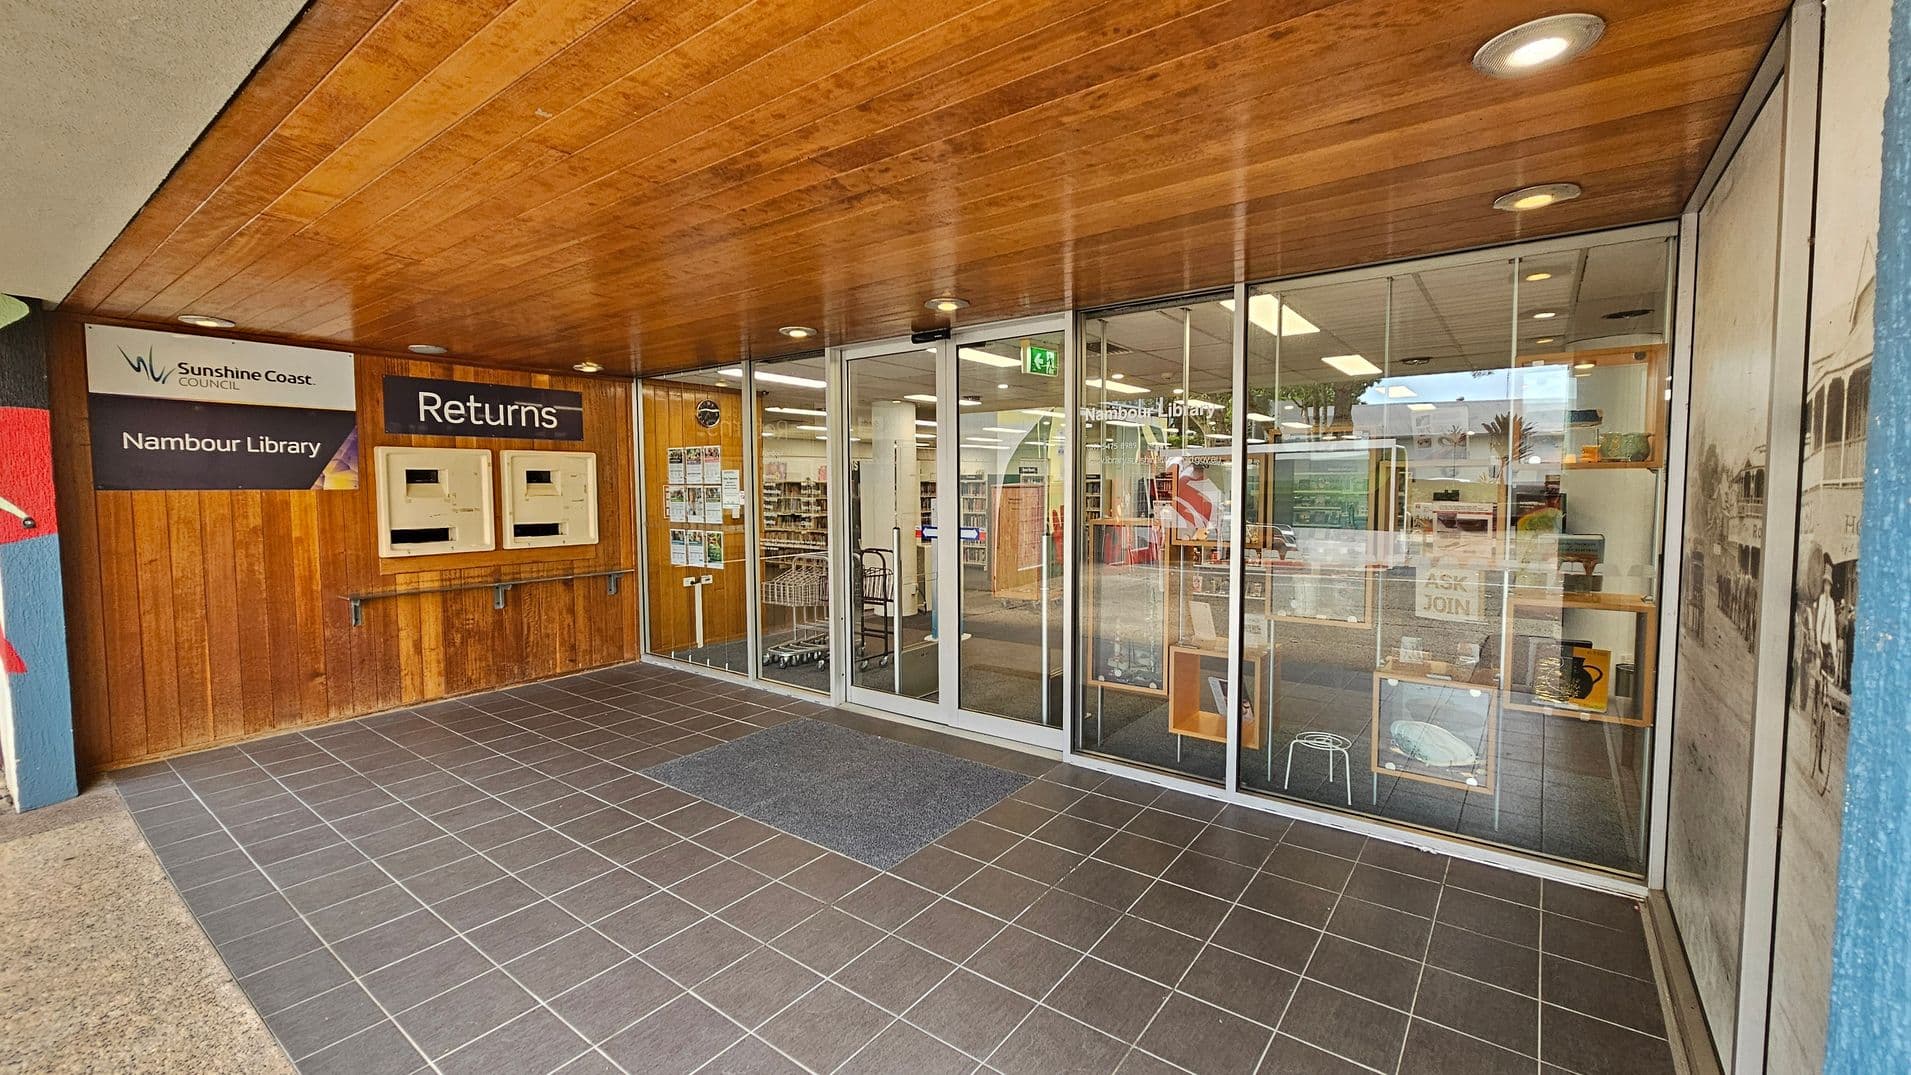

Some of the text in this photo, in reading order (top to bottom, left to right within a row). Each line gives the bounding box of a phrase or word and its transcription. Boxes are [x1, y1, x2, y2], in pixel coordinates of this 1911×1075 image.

[177, 361, 313, 386] Sunshine Coast
[178, 376, 241, 391] COUNCIL
[418, 391, 559, 429] Returns
[1085, 396, 1215, 421] Nambour Library
[122, 431, 321, 458] Nambour Library
[1423, 572, 1469, 593] ASK
[1422, 592, 1471, 615] JOIN
